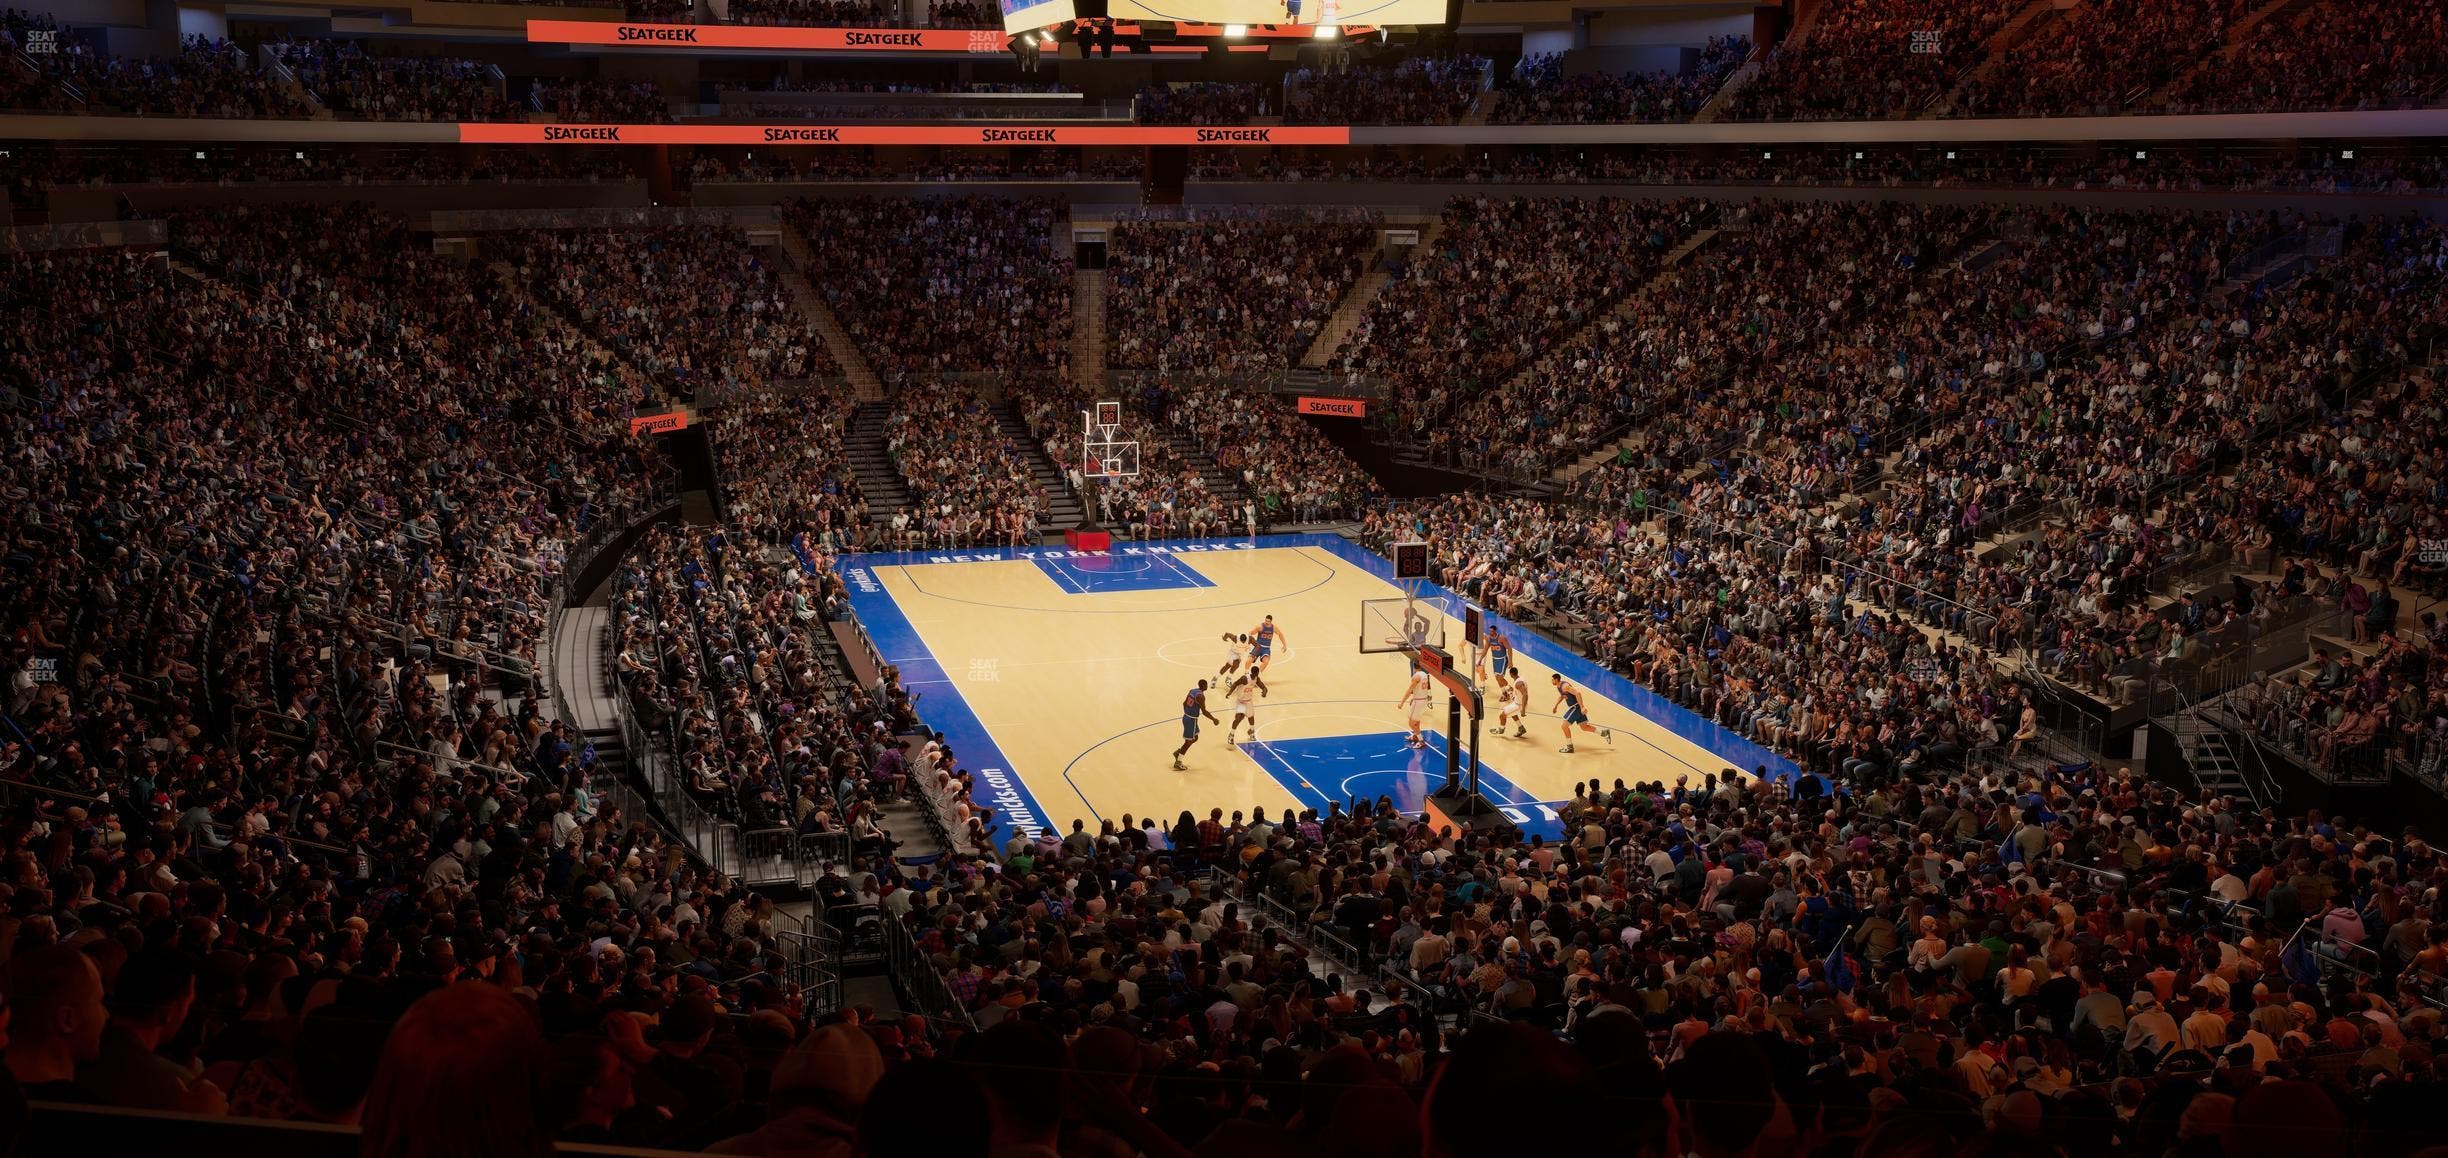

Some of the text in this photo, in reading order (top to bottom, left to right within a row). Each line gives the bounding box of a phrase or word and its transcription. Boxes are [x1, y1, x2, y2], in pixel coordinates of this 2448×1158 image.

[617, 26, 922, 46] SEATGEEK SEATGEEK
[544, 127, 1270, 142] SEATGEEK SEATGEEK SEATGEEK SEATGEEK
[1310, 402, 1354, 414] SEATGEEK
[929, 543, 1256, 564] NEW YORK KNICKS
[981, 768, 1044, 838] nyknicks.com
